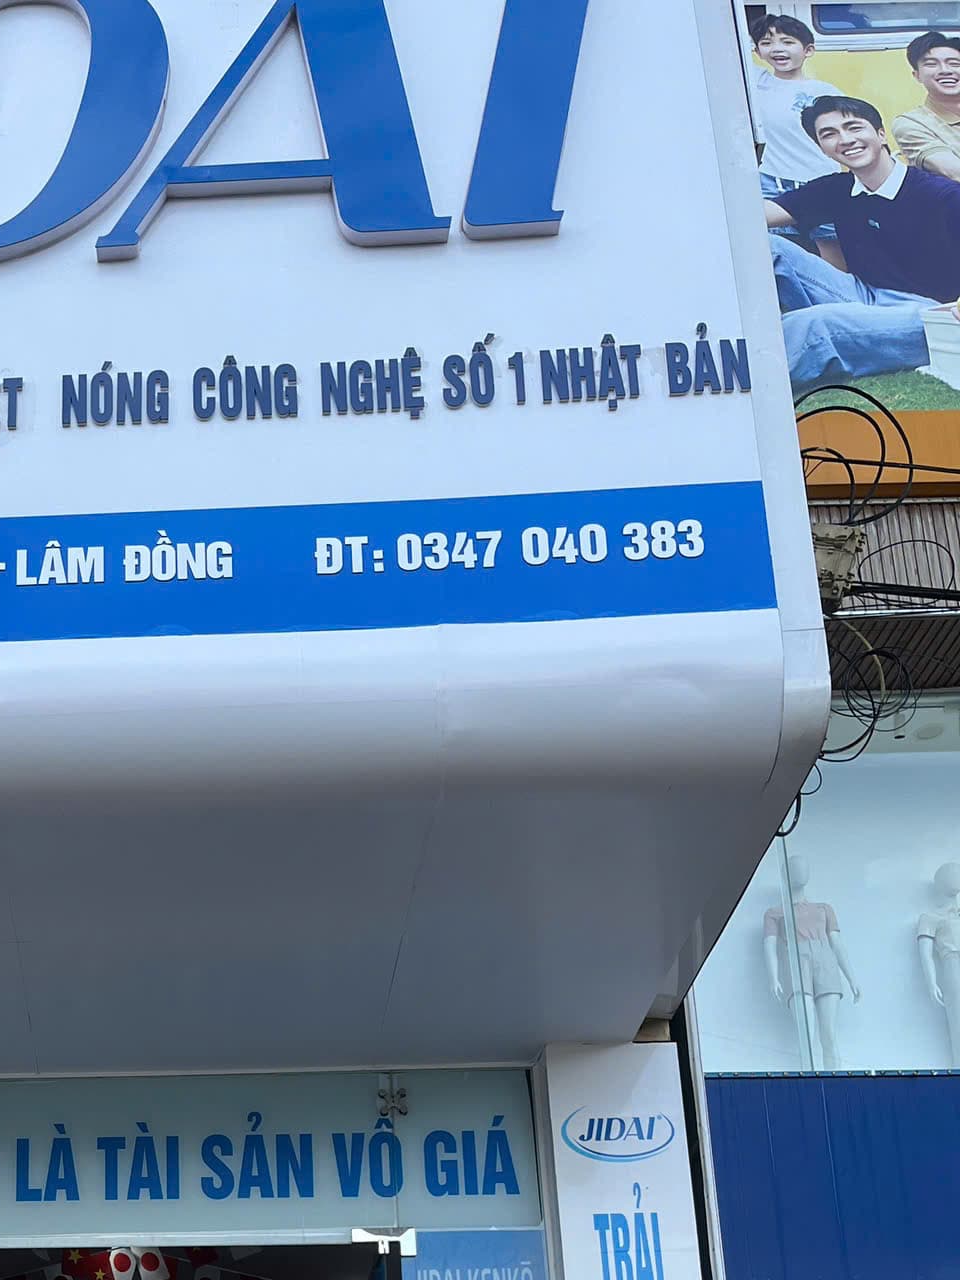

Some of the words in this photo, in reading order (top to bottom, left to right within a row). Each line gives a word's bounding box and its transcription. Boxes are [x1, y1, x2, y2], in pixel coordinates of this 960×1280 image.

[62, 361, 169, 427] NÓNG
[193, 355, 298, 421] CÔNG
[320, 347, 424, 419] NGHỆ
[442, 333, 495, 410] SỐ
[508, 351, 526, 405] 1
[540, 334, 641, 411] NHẬT
[665, 322, 751, 397] BẢN
[16, 540, 105, 586] LÂM
[123, 530, 233, 582] ĐỒNG
[314, 536, 385, 575] ĐT:
[396, 530, 502, 571] 0347
[521, 524, 608, 566] 040
[623, 519, 705, 561] 383
[16, 1123, 80, 1202] LÀ
[97, 1122, 180, 1201] TÀI
[200, 1112, 315, 1200] SẢN
[332, 1118, 404, 1198] VÔ
[423, 1115, 521, 1197] GIÁ
[579, 1116, 656, 1142] JIDAI
